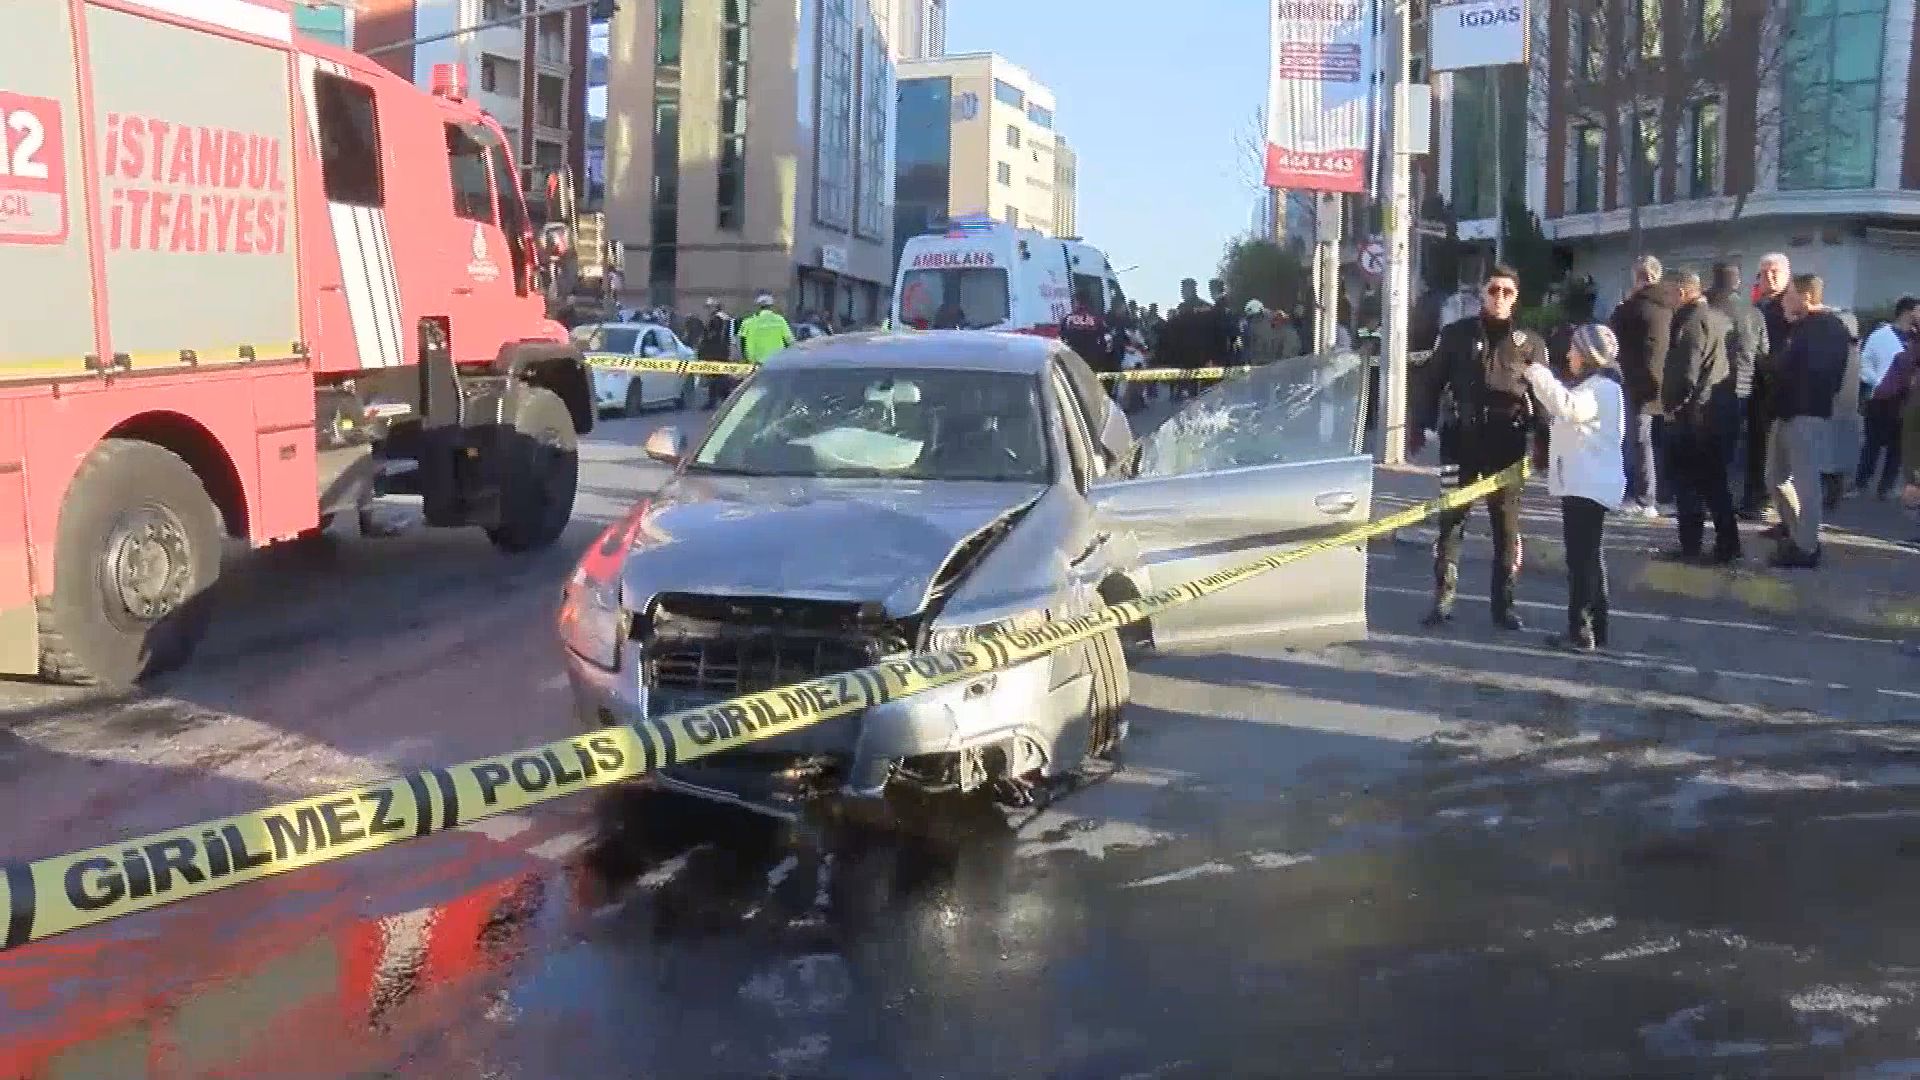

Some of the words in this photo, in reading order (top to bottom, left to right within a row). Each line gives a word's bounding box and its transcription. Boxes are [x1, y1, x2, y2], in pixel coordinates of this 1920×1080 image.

[105, 112, 285, 191] İSTANBUL
[110, 187, 286, 254] İTFAİYESİ
[913, 252, 995, 267] AMBULANS
[63, 786, 405, 911] GİRİLMEZ
[470, 736, 624, 804] POLİS
[681, 675, 860, 744] GİRİLMEZ
